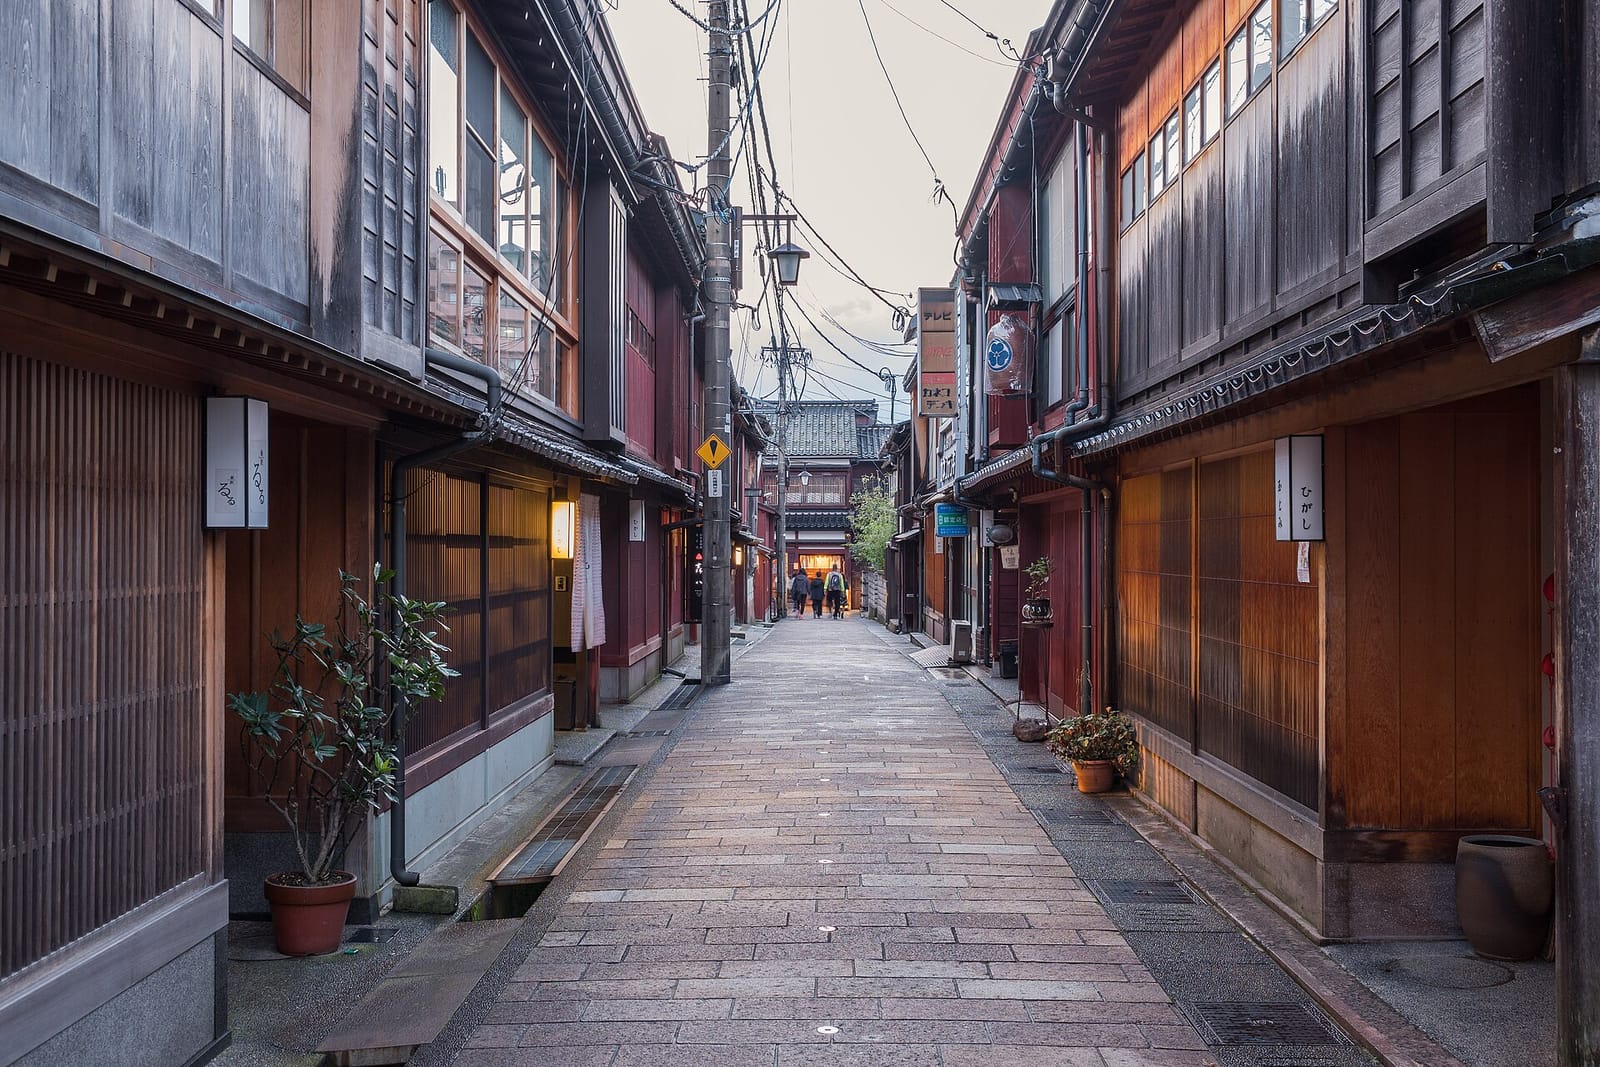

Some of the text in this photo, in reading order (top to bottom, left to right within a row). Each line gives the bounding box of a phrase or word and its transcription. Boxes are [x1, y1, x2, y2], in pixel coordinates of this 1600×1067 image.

[923, 311, 952, 321] テレビ
[1301, 486, 1312, 530] ひがし
